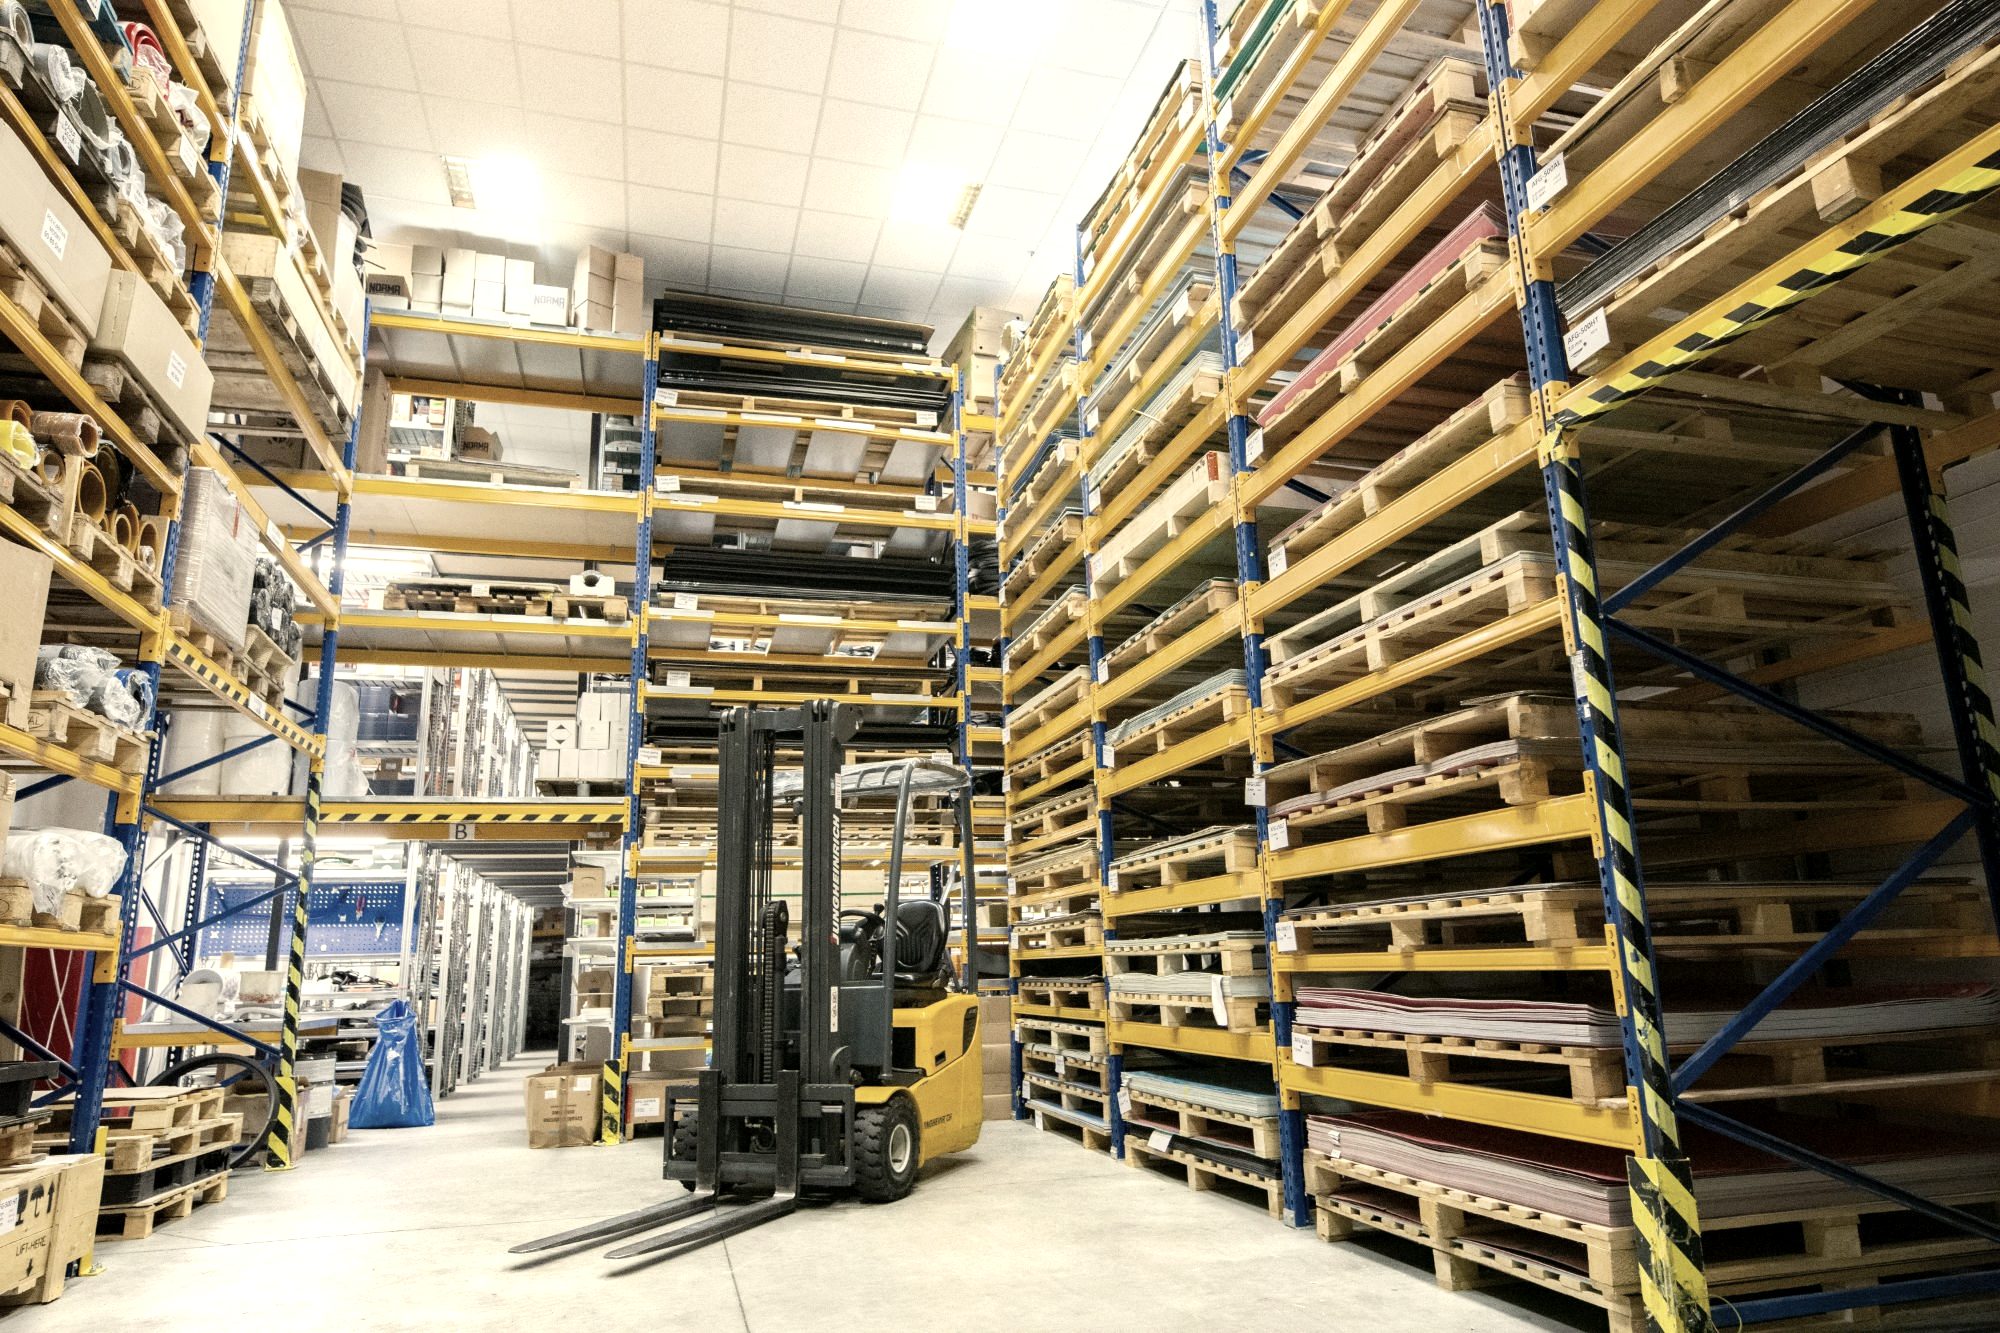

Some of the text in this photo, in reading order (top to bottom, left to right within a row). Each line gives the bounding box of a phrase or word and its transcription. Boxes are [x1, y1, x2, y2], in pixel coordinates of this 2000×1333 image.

[368, 282, 401, 296] NORMA
[534, 295, 565, 309] NORMA
[1567, 316, 1599, 345] AFG-500HT
[463, 441, 489, 453] NORMA
[455, 823, 468, 840] B
[832, 814, 840, 945] JUNGHEINRICH
